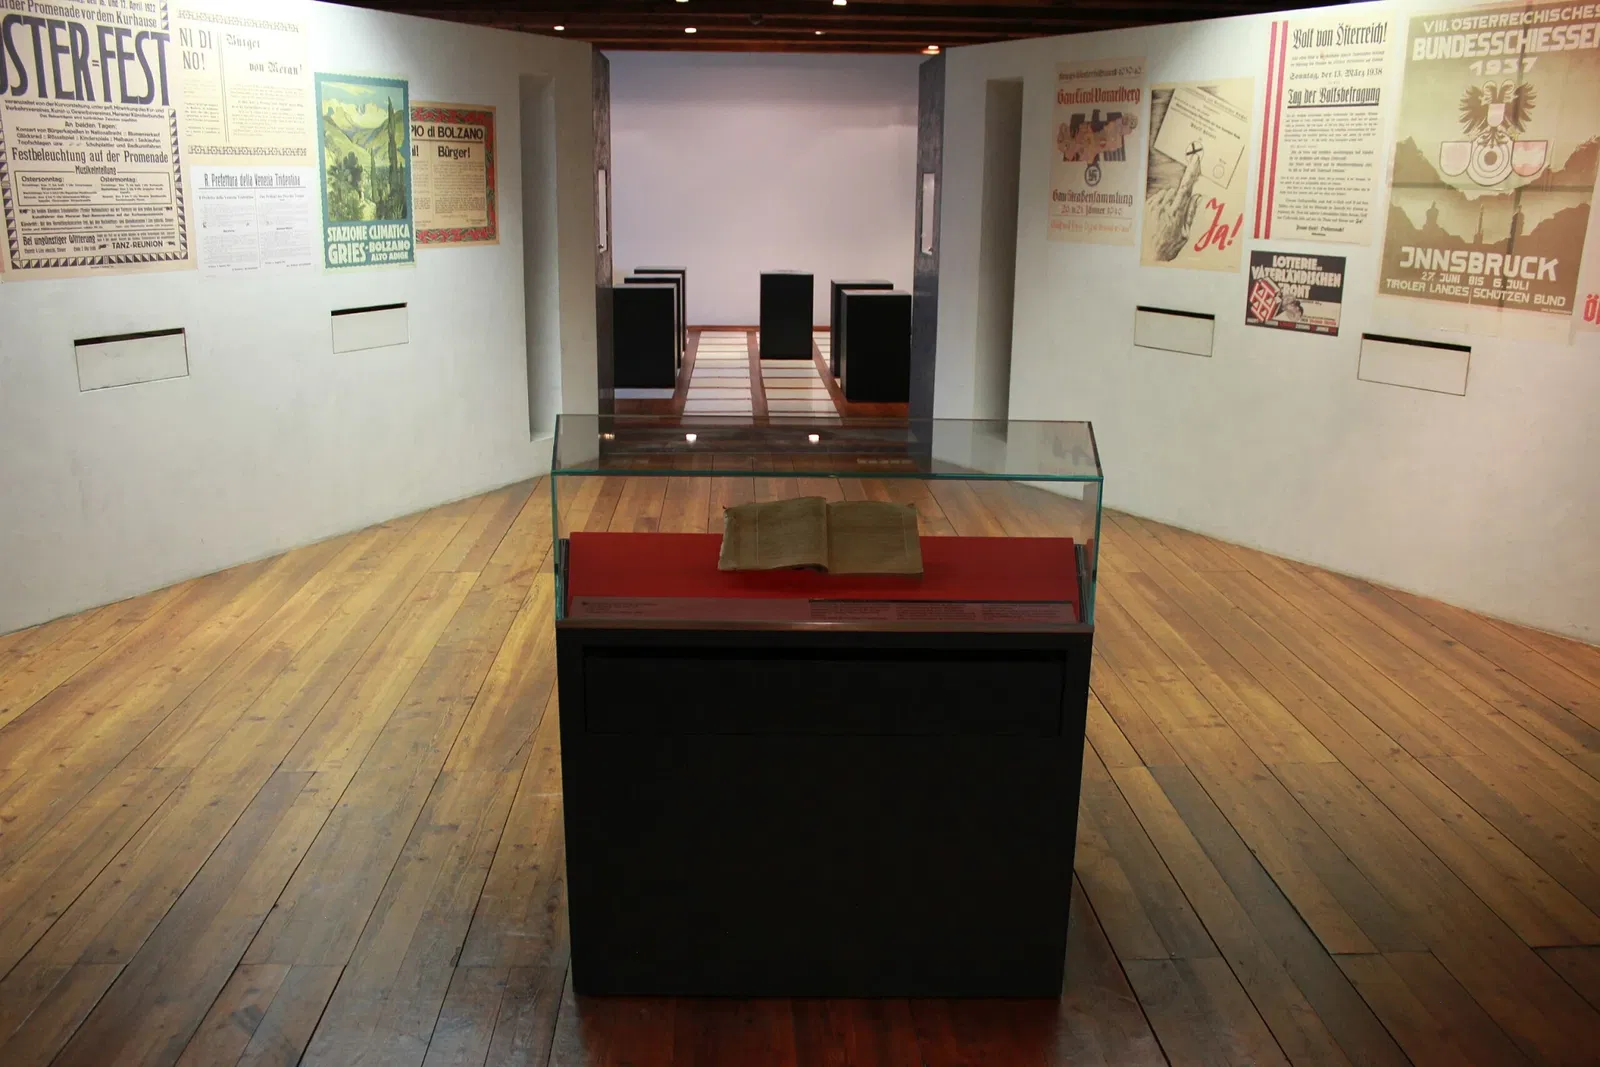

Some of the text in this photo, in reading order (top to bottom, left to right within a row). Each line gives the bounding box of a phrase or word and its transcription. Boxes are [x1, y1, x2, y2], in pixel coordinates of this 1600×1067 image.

[9, 0, 25, 11] der
[28, 0, 80, 18] Promenade
[81, 9, 96, 20] vor
[97, 9, 114, 22] dem
[116, 11, 157, 27] Kurhause
[130, 1, 142, 11] April
[144, 3, 156, 12] 1922
[1316, 29, 1333, 47] von
[1336, 21, 1388, 46] Österreich!
[1423, 20, 1449, 33] VIII.
[198, 30, 212, 49] DI
[182, 50, 205, 70] NO!
[1469, 56, 1538, 76] 1937
[1304, 88, 1317, 103] der
[427, 125, 435, 137] di
[438, 126, 483, 140] BOLZANO
[12, 148, 168, 164] Festbeleuchtung auf der Promenade
[438, 146, 471, 160] Bürger!
[211, 173, 238, 187] Prefettura
[240, 173, 253, 187] della
[255, 173, 273, 186] Venezia
[275, 173, 300, 186] Tridentina
[327, 223, 410, 242] STAZIONE CLIMATICA
[1194, 197, 1243, 252] Ja!
[112, 241, 163, 249] TANZ-REUNION
[328, 240, 410, 265] GRIES BOLZANO
[371, 251, 409, 262] ALTO ADIGE
[1272, 255, 1318, 270] LOTTERIE
[1251, 264, 1342, 288] VATERLÄNDISCHEN
[1422, 272, 1529, 290] 27. JUNI BIS 6. JULI
[1278, 283, 1311, 299] FRONT
[1386, 278, 1566, 306] TIROLER LANDES SCHÜTZEN BUND
[1584, 294, 1600, 325] Ö
